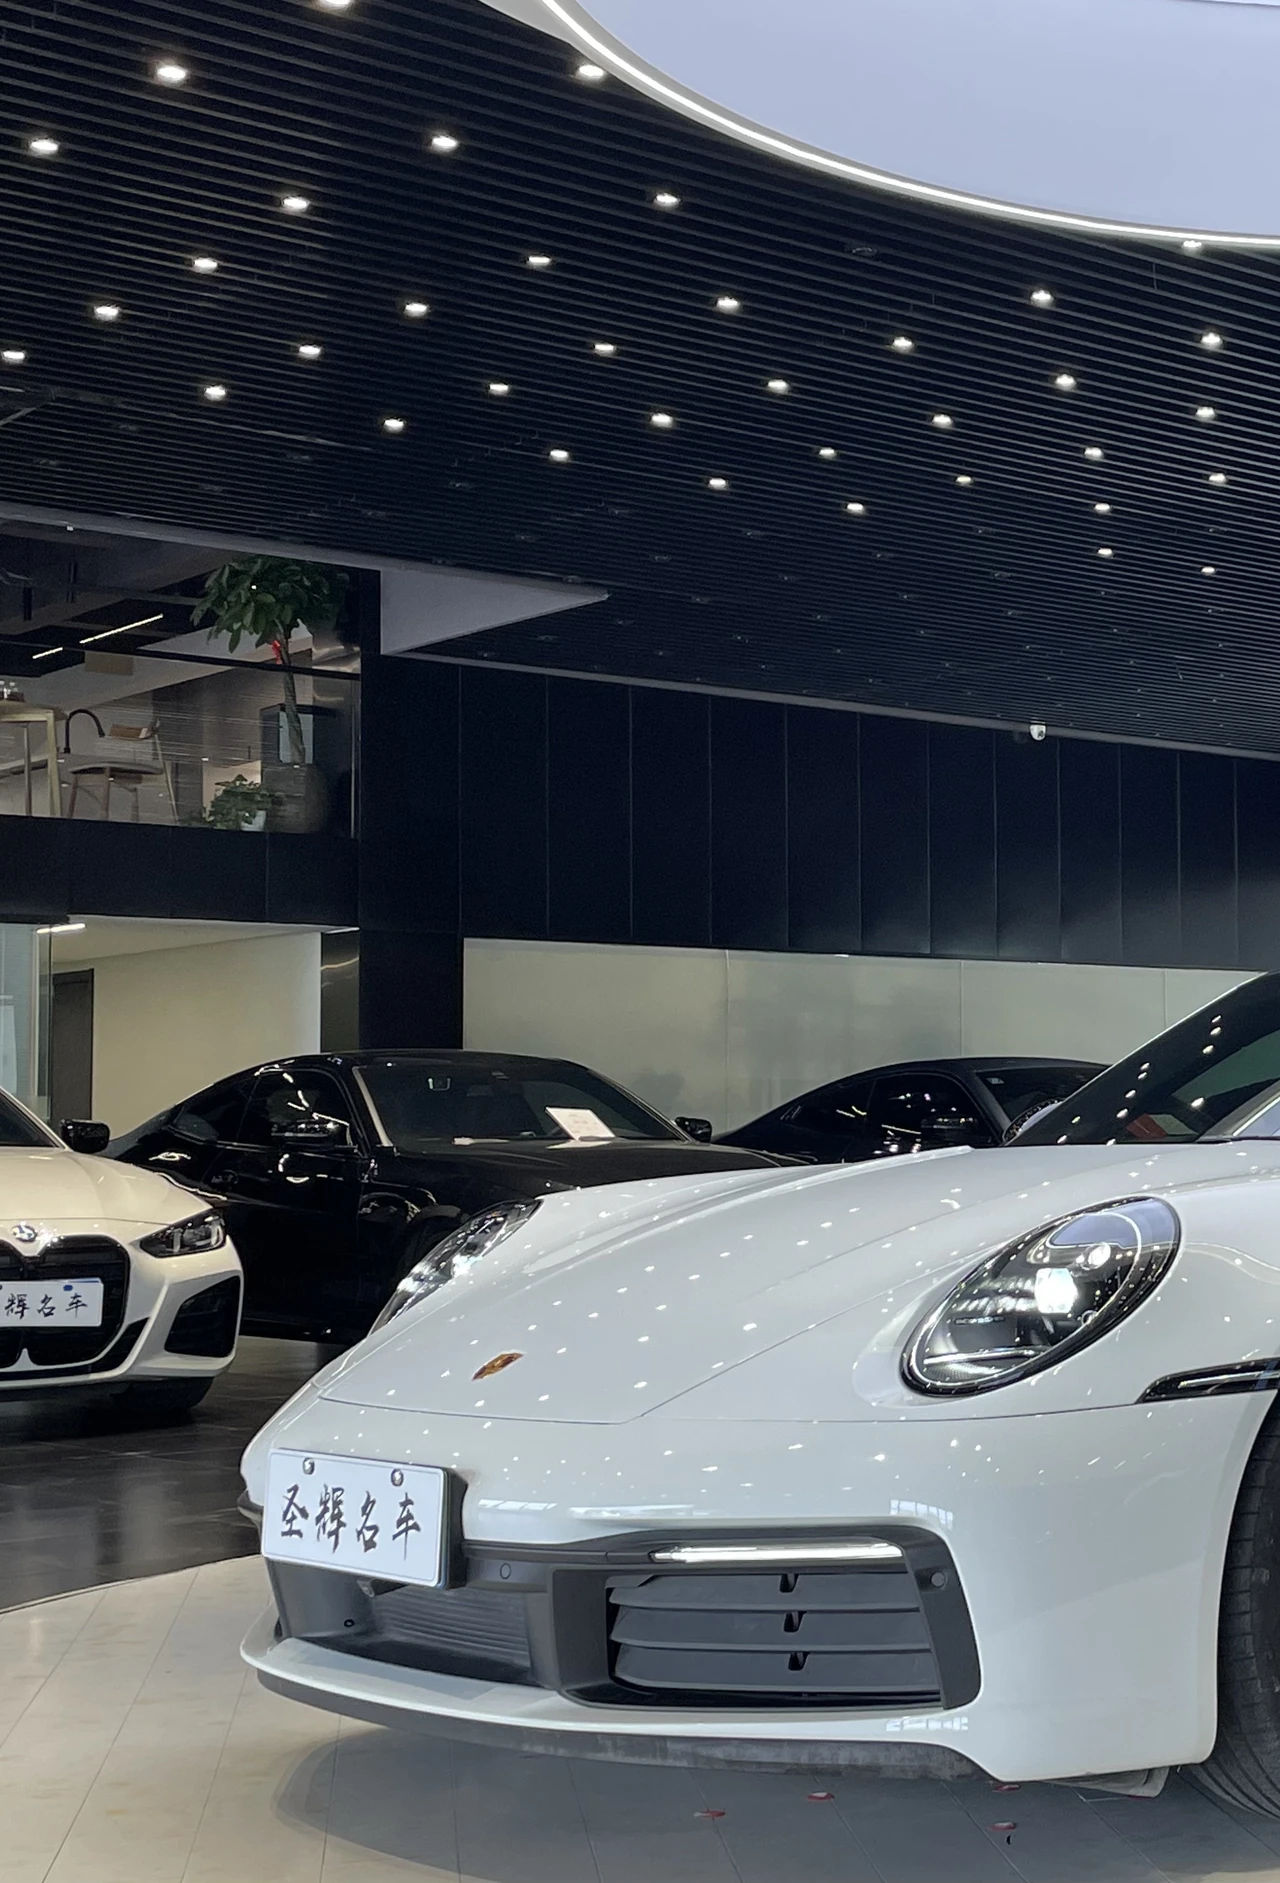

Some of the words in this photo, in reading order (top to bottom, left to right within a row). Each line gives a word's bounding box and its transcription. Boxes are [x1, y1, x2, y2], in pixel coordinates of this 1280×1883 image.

[4, 1293, 88, 1320] 辉名车
[281, 1483, 421, 1561] 圣辉名车
